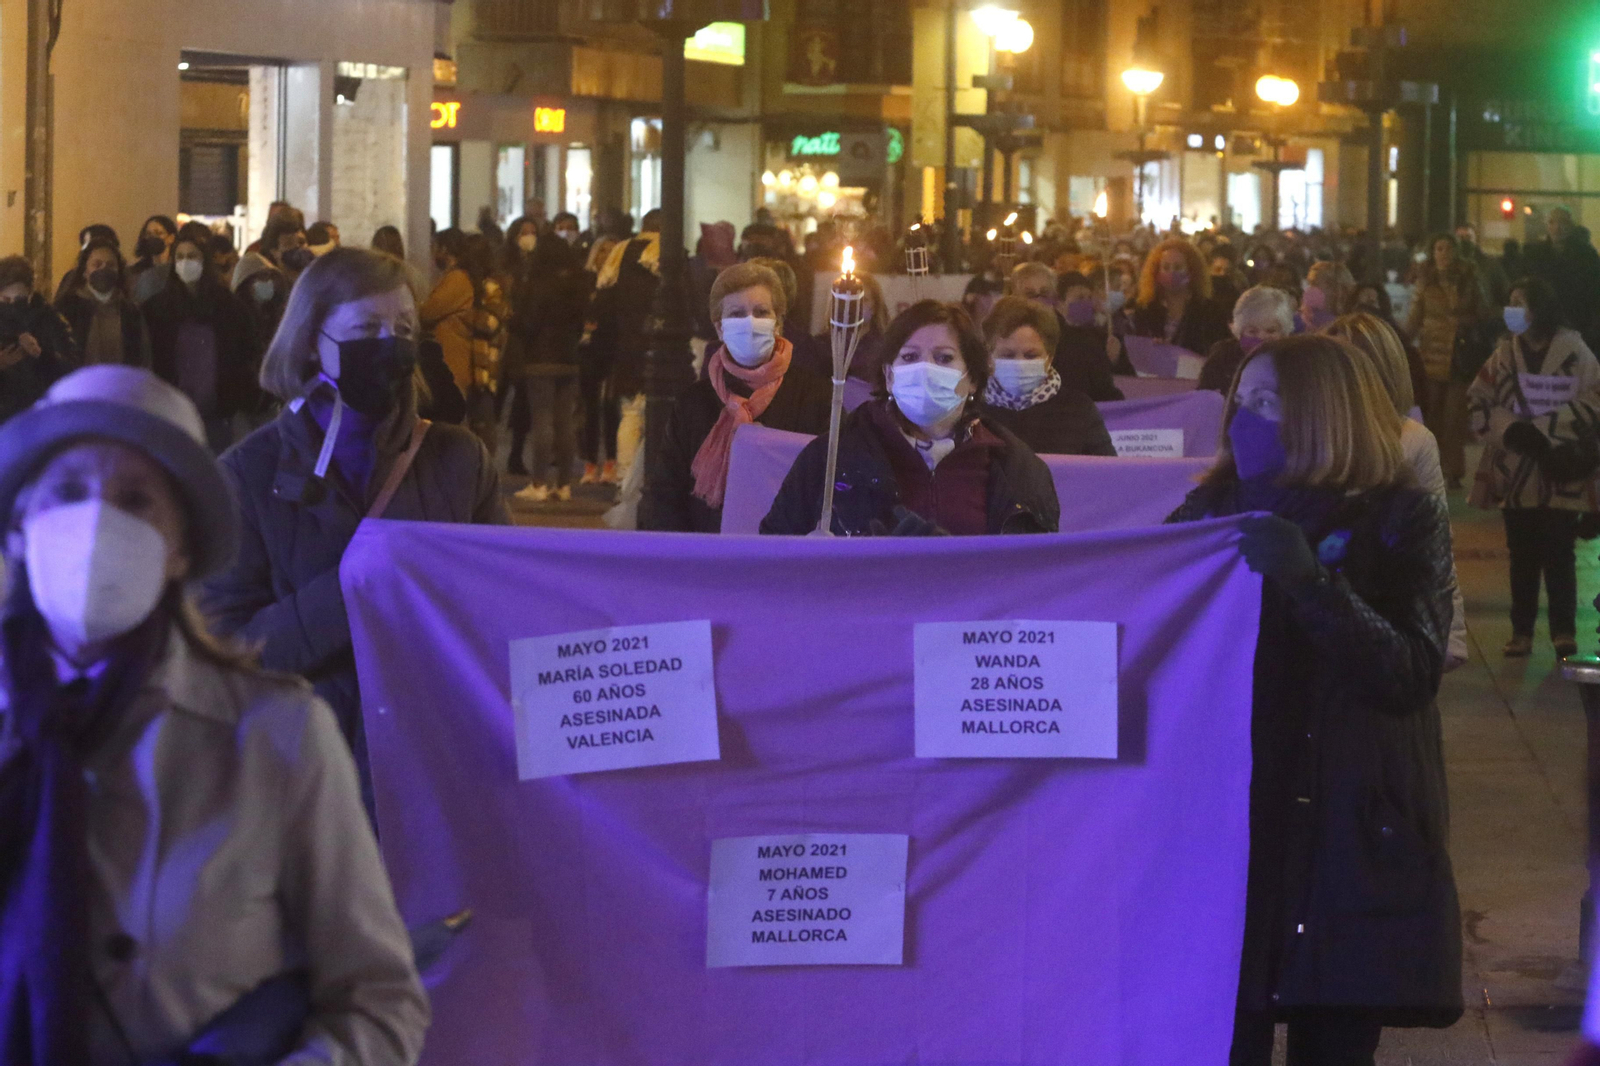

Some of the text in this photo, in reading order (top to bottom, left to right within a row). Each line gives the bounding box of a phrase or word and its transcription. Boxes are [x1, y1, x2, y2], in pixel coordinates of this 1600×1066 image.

[962, 631, 1055, 644] MAYO 2021
[557, 636, 649, 658] MAYO 2021
[975, 655, 1041, 668] WANDA
[538, 657, 682, 685] MARÍA SOLEDAD
[970, 674, 1044, 690] 28 AÑOS
[573, 683, 646, 704] 60 AÑOS
[960, 699, 1062, 712] ASESINADA
[560, 704, 661, 728] ASESINADA
[961, 720, 1060, 734] MALLORCA
[566, 728, 654, 750] VALENCIA
[757, 844, 847, 859] MAYO 2021
[759, 866, 847, 881] MOHAMED
[767, 885, 829, 901] 7 AÑOS
[752, 908, 852, 922] ASESINADO
[751, 929, 848, 943] MALLORCA
